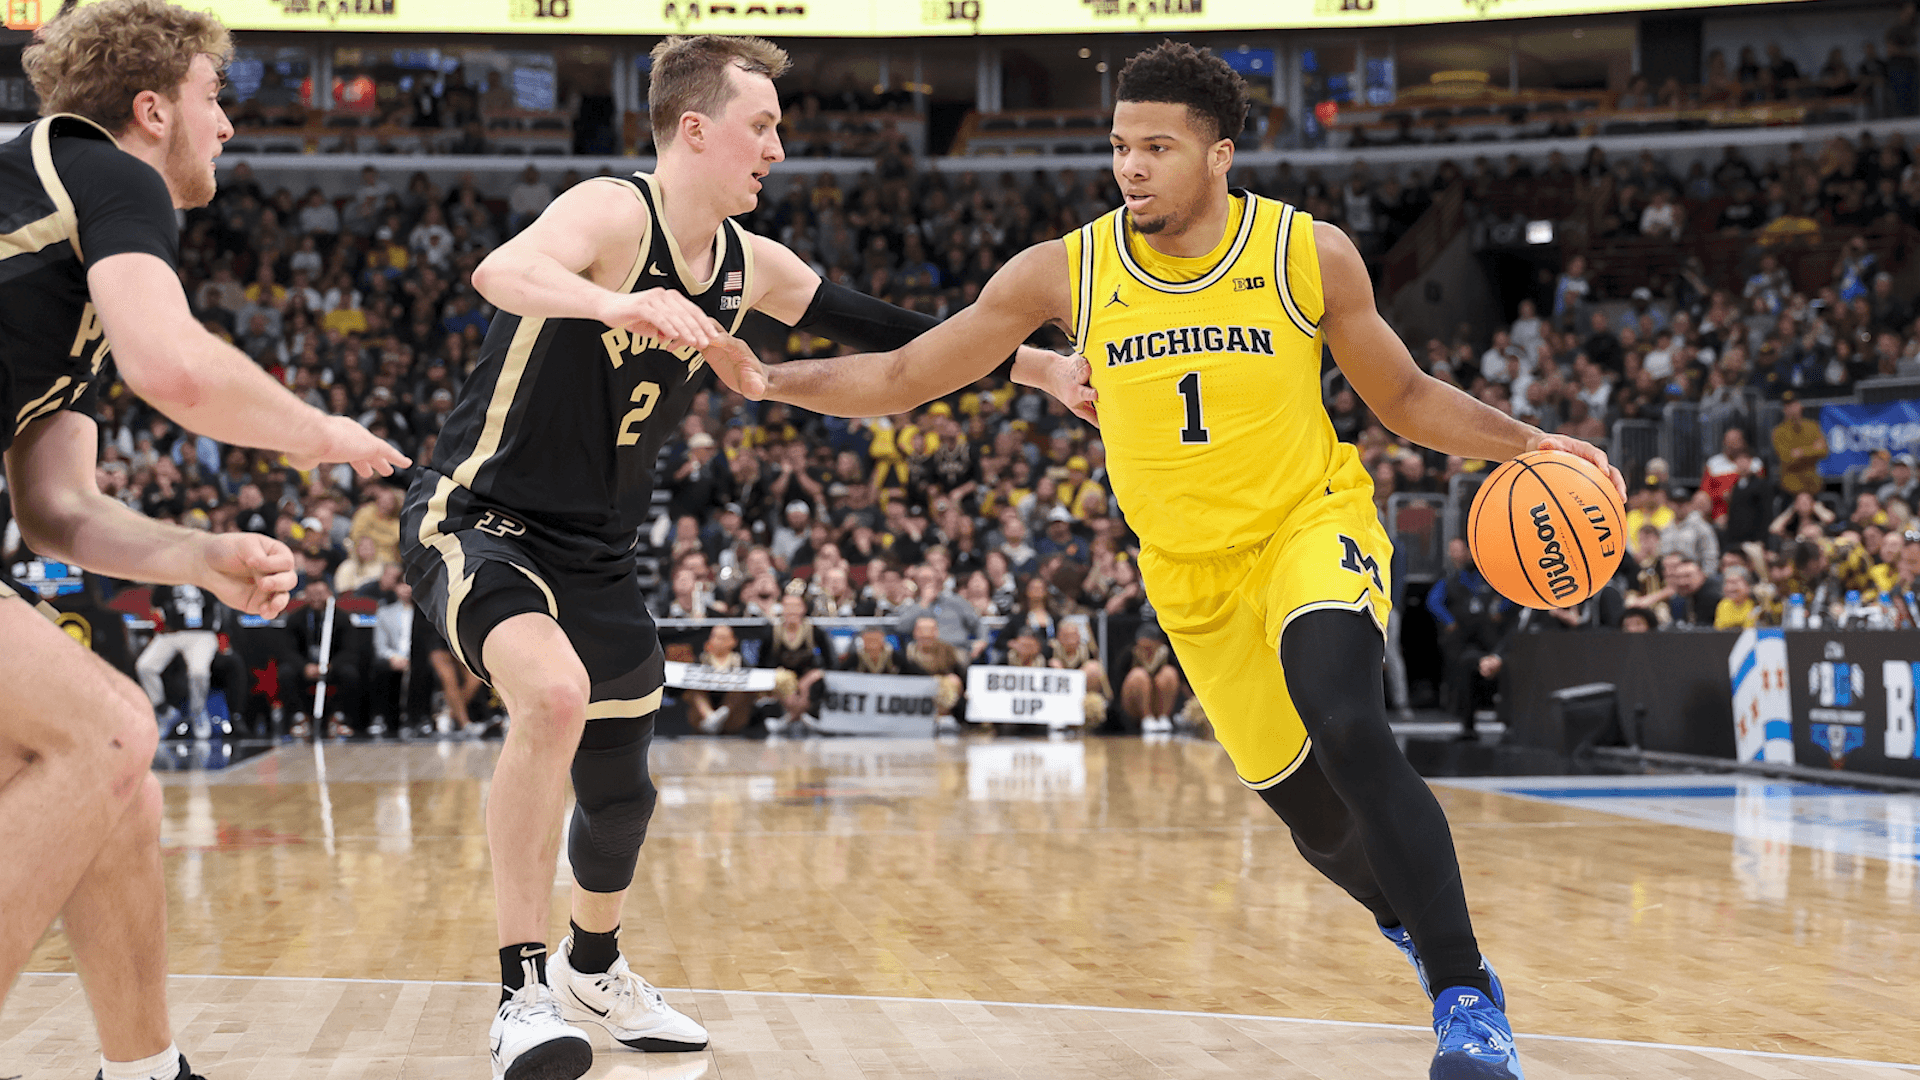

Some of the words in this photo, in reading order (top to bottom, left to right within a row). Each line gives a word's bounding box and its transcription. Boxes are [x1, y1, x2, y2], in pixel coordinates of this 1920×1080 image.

[1106, 326, 1276, 368] MICHIGAN
[616, 381, 661, 446] 2
[1176, 371, 1211, 445] 1
[474, 508, 527, 537] P
[1582, 505, 1616, 558] EVO
[1337, 533, 1385, 596] M
[1530, 502, 1579, 600] Wilson
[987, 673, 1071, 694] BOILER
[1013, 698, 1043, 715] UP
